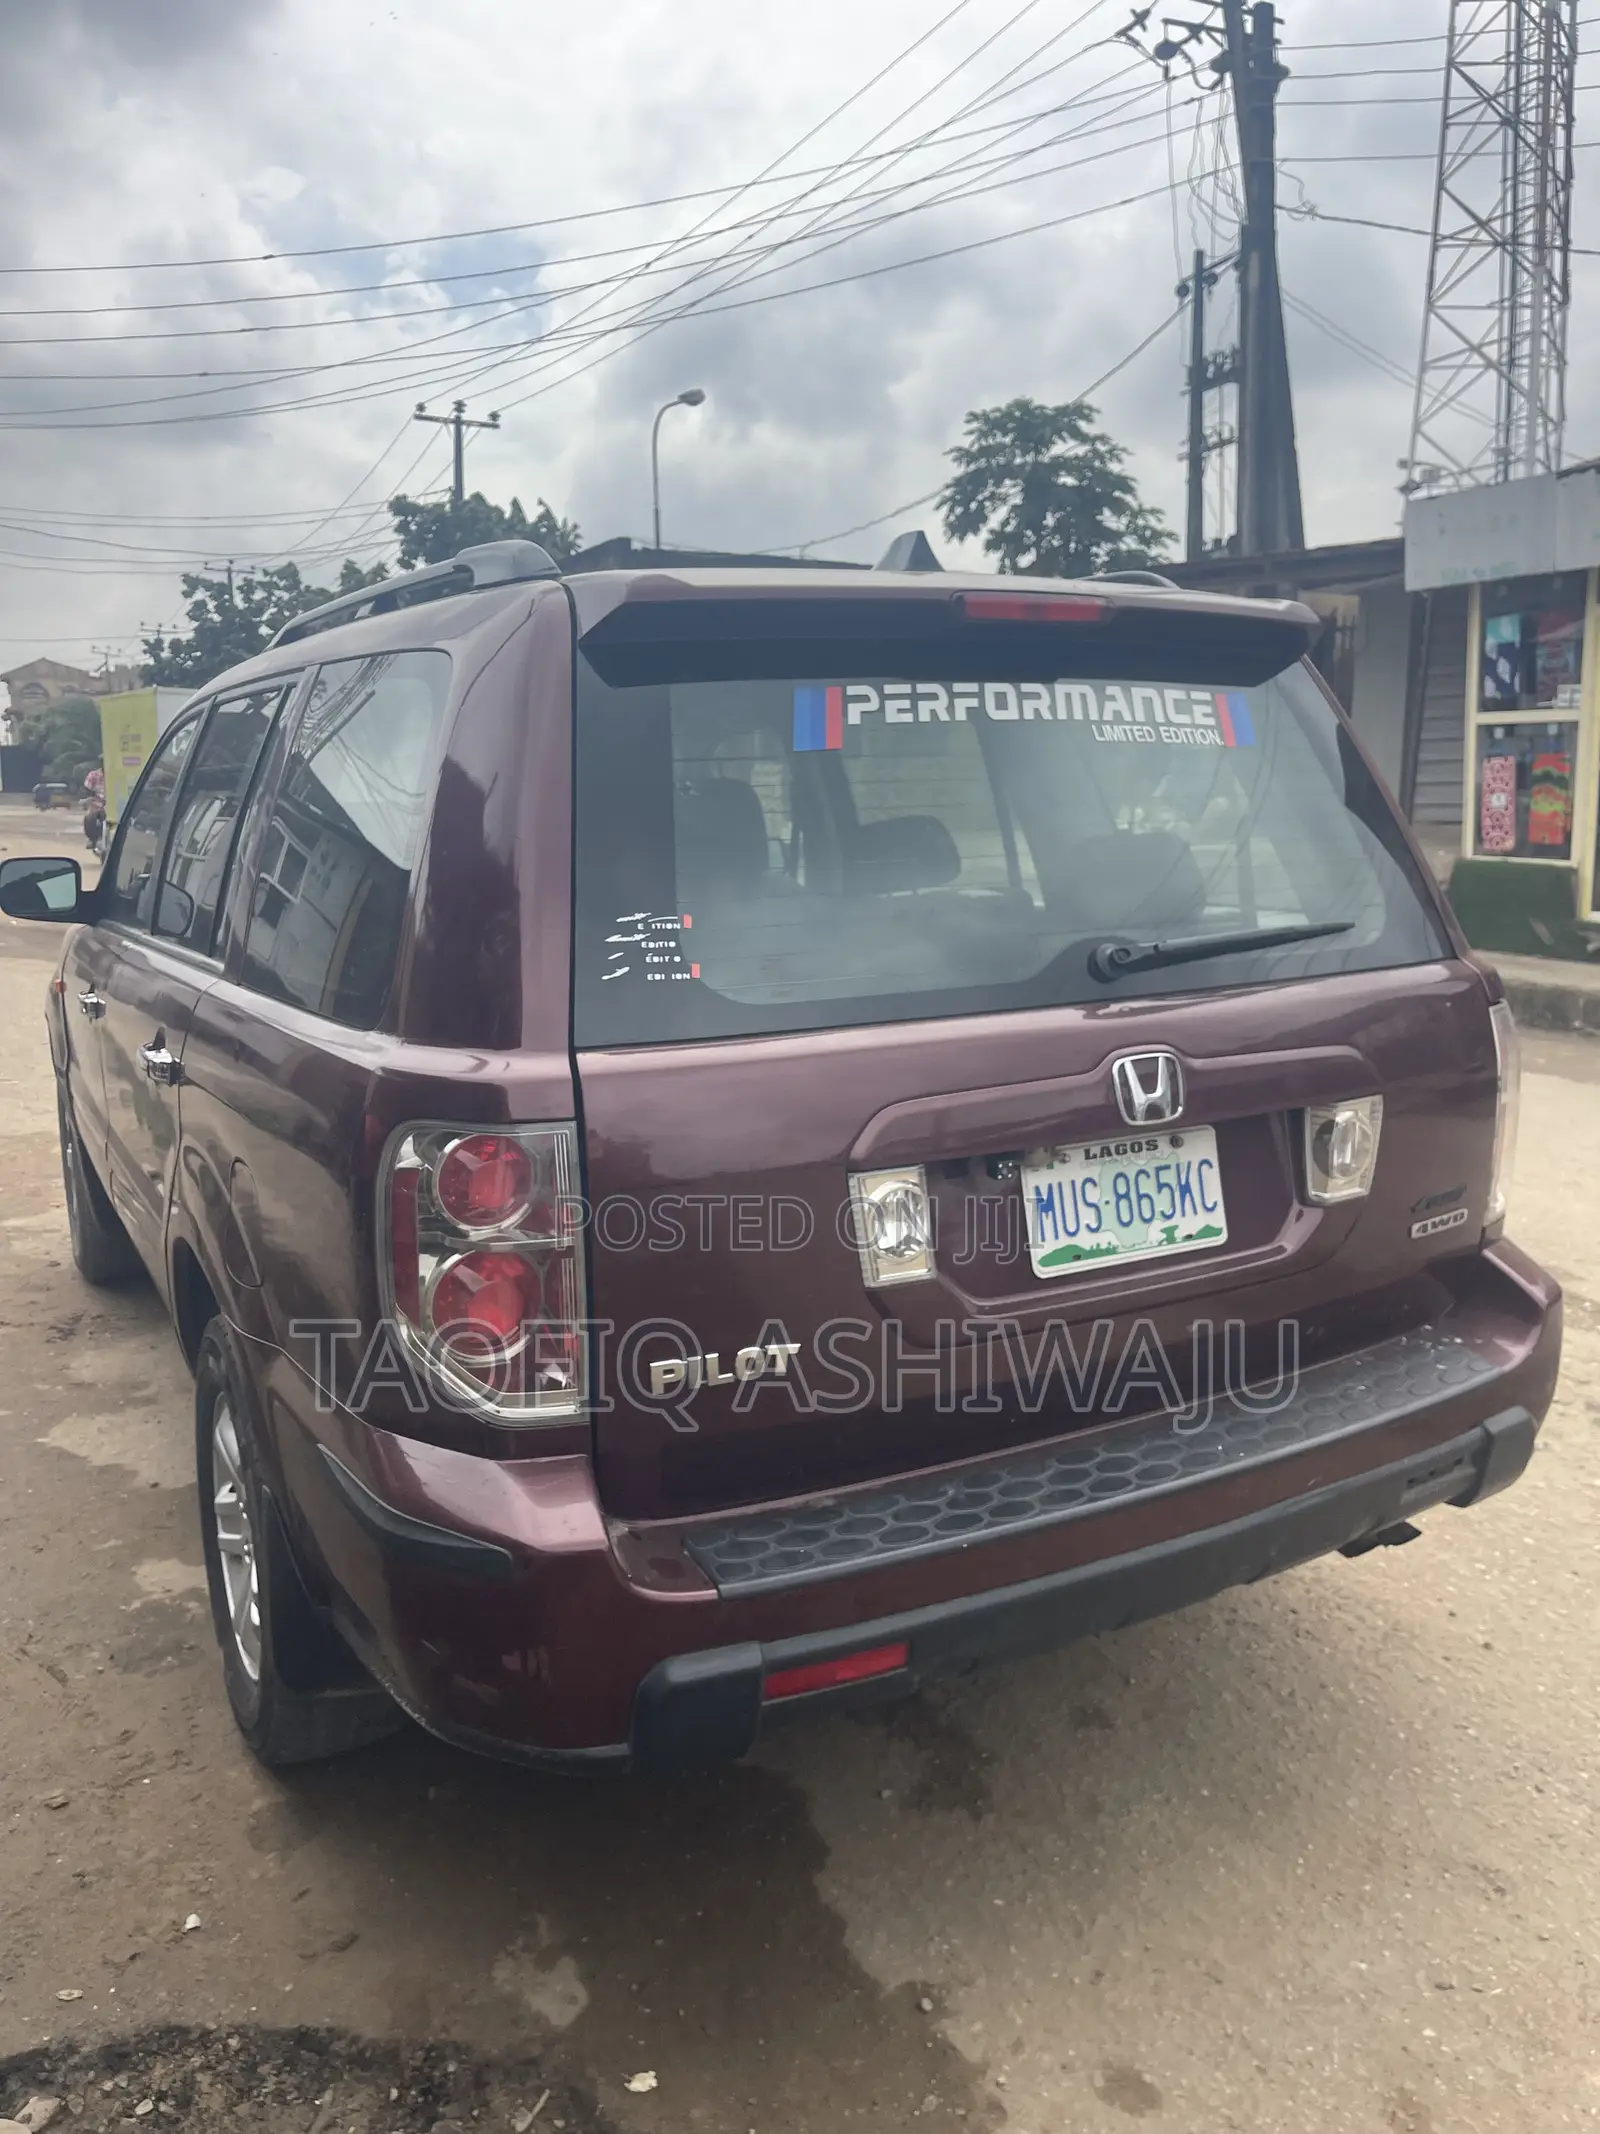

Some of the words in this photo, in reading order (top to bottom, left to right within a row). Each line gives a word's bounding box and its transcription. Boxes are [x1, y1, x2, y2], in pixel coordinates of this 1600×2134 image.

[846, 683, 1216, 725] PERFORMANCE
[1092, 724, 1156, 743] LIMITED
[1083, 1139, 1159, 1160] LAGOS
[650, 1344, 801, 1395] PILOT
